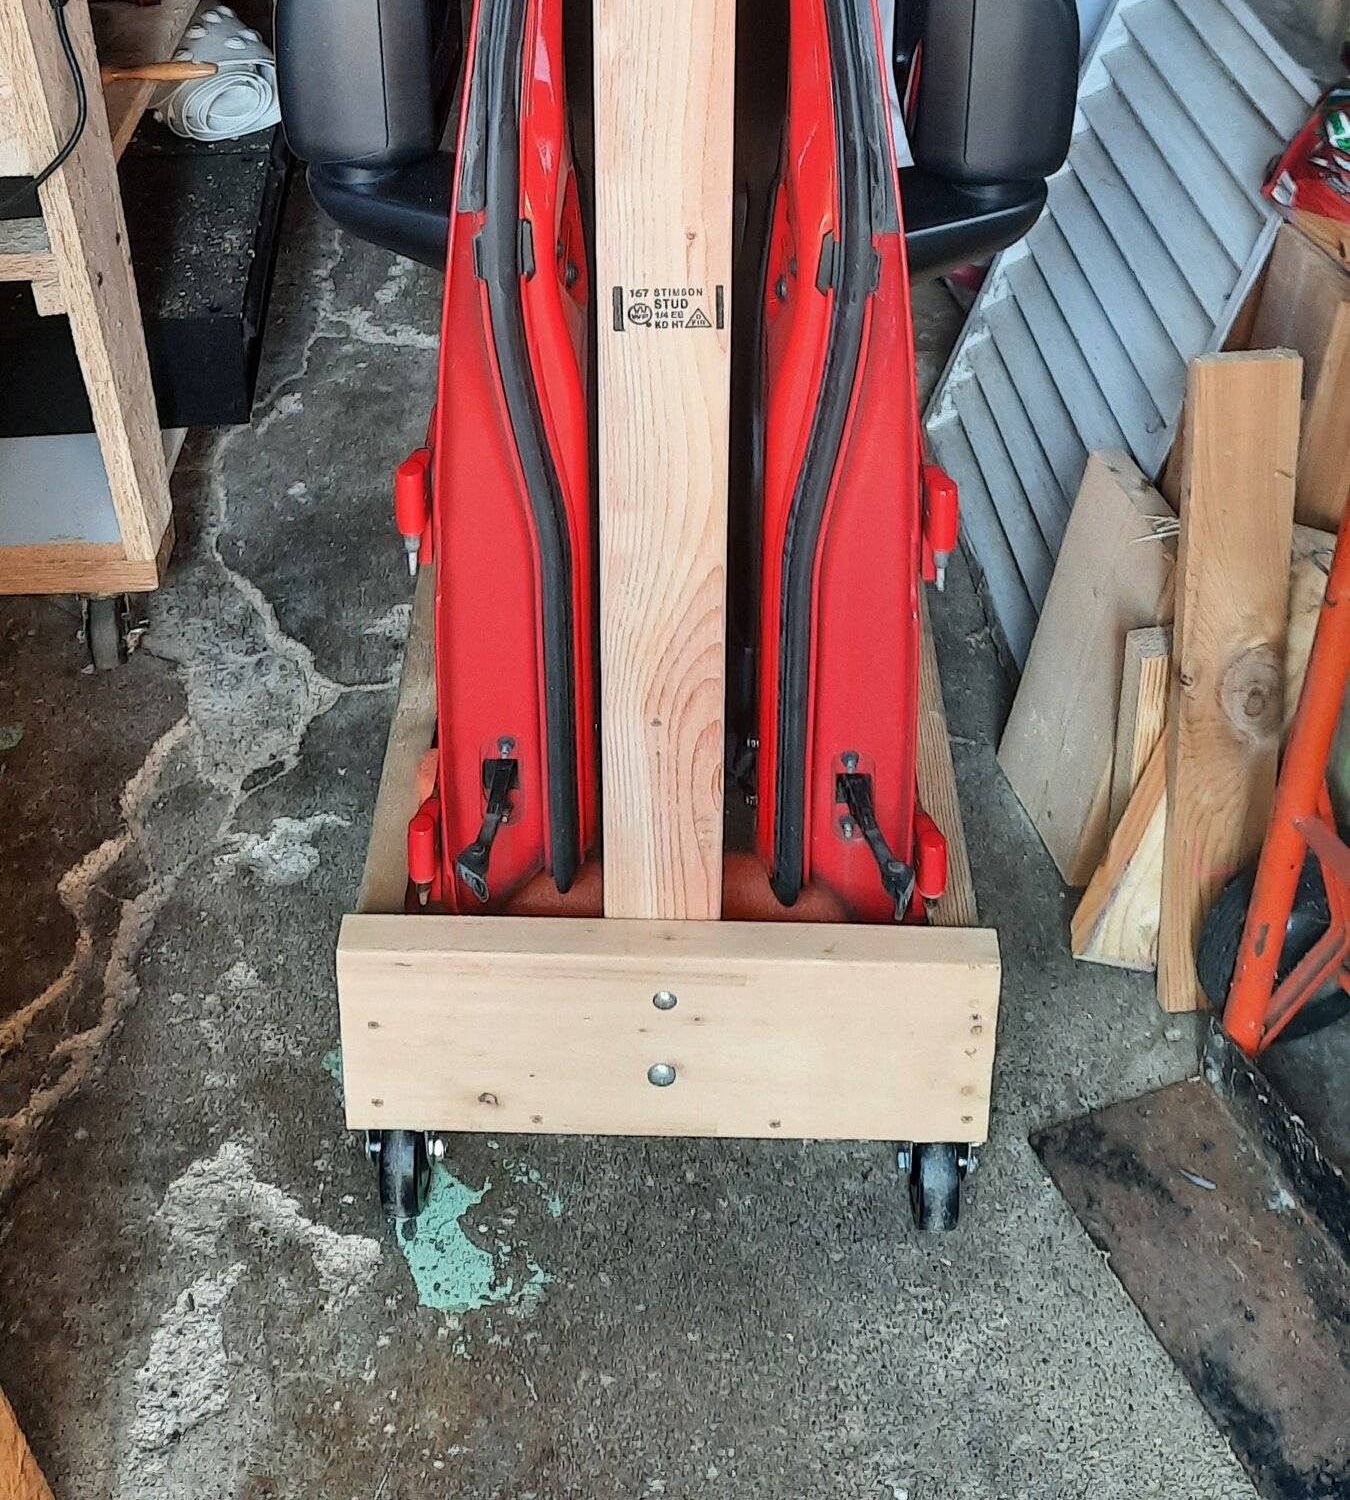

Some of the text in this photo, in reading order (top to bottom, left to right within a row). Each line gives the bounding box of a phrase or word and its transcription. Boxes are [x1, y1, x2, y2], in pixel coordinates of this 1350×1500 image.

[630, 288, 703, 298] 167 STIMSON
[654, 299, 688, 309] STUD
[655, 321, 668, 329] KD
